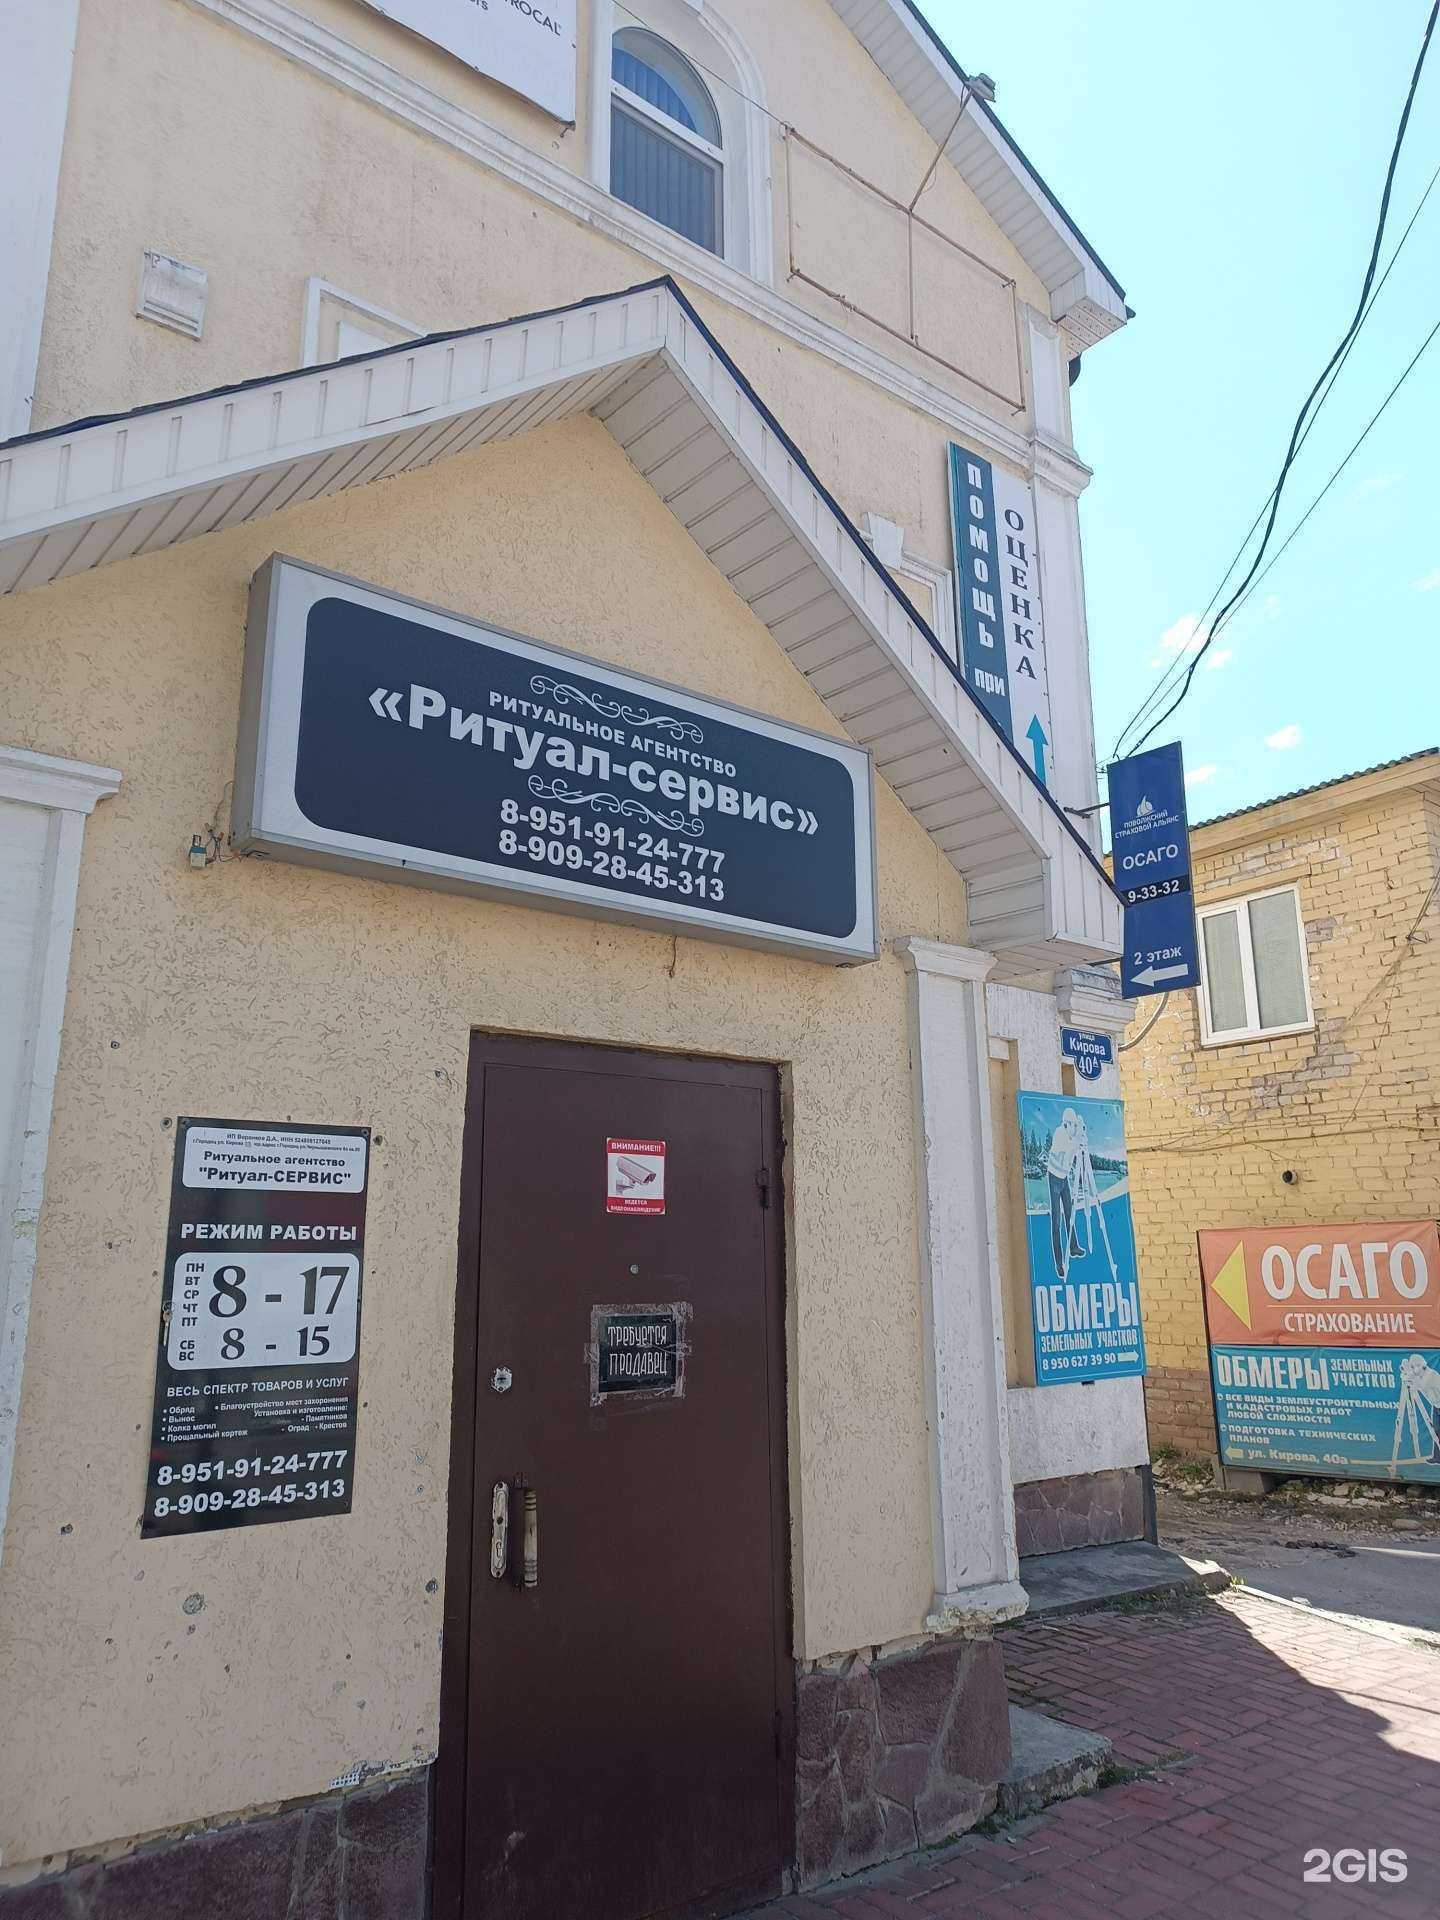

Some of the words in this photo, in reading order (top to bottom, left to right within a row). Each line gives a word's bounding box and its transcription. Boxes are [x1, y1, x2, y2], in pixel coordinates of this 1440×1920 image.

[967, 462, 997, 648] ПОМОЩЬ
[1004, 508, 1037, 680] ОЦЕНКА
[974, 667, 1006, 696] при
[488, 691, 625, 746] РИТУАЛЬНОЕ
[631, 734, 736, 778] АГЕНТСТВО
[368, 683, 819, 837] «Ритуал-сервис»
[1115, 822, 1152, 839] СТРАХОВОЙ
[1153, 815, 1179, 829] АЛЬЯНС
[1123, 809, 1168, 829] ПОВОЛЖСКИЙ
[500, 798, 726, 875] 8-951-91-24-777
[499, 829, 725, 901] 8-909-28-45-313
[1122, 844, 1179, 870] ОСАГО
[1128, 879, 1179, 903] 9-33-32
[1134, 952, 1142, 965] 2
[1146, 946, 1182, 962] этаж
[1070, 1037, 1105, 1055] Кирова
[611, 1142, 661, 1152] ВНИМАНИЕ!!!
[203, 1151, 281, 1165] Ритуальное
[284, 1156, 346, 1168] агентство
[199, 1167, 351, 1185] "Ритуал-СЕРВИС"
[181, 1223, 263, 1240] РЕЖИМ
[270, 1224, 356, 1241] РАБОТЫ
[186, 1263, 204, 1272] ПН
[1261, 1241, 1429, 1300] ОСАГО
[185, 1277, 200, 1285] ВТ
[184, 1290, 199, 1299] СР
[208, 1265, 247, 1318] 8
[300, 1266, 350, 1315] 17
[182, 1303, 198, 1313] ЧТ
[1035, 1282, 1139, 1332] ОБМЕРЫ
[181, 1317, 198, 1326] ПТ
[1284, 1312, 1417, 1334] СТРАХОВАНИЕ
[179, 1340, 195, 1350] СБ
[220, 1328, 245, 1360] 8
[297, 1325, 330, 1356] 15
[1041, 1332, 1093, 1353] ЗЕМЕЛЬНЫХ
[1097, 1329, 1138, 1348] УЧАСТКОВ
[178, 1351, 195, 1361] ВС
[1042, 1359, 1049, 1370] 8
[1051, 1357, 1069, 1370] 950
[1071, 1355, 1088, 1368] 627
[1090, 1355, 1103, 1366] 39
[1104, 1354, 1116, 1364] 90
[1216, 1355, 1330, 1391] ОБМЕРЫ
[1330, 1358, 1393, 1373] ЗЕМЕЛЬНЫХ
[167, 1384, 200, 1397] ВЕСЬ
[203, 1382, 248, 1395] СПЕКТР
[252, 1379, 303, 1392] ТОВАРОВ
[306, 1380, 314, 1389] И
[315, 1377, 349, 1389] УСЛУГ
[1331, 1372, 1396, 1389] УЧАСТКОВ
[220, 1400, 284, 1411] Благоустройство
[286, 1399, 302, 1407] мест
[1225, 1393, 1243, 1401] ВСЕ
[1244, 1394, 1274, 1404] ВИДЫ
[169, 1406, 195, 1414] Обряд
[254, 1408, 291, 1417] Установка
[305, 1413, 347, 1422] Памятников
[1227, 1410, 1264, 1420] ЛЮБОЙ
[1266, 1413, 1331, 1424] СЛОЖНОСТИ
[1236, 1403, 1313, 1415] КАДАСТРОВЫХ
[1316, 1408, 1352, 1416] РАБОТ
[168, 1415, 195, 1423] Вынос
[319, 1422, 347, 1431] Крестов
[167, 1431, 220, 1442] Прощальный
[287, 1424, 310, 1433] Оград
[1228, 1424, 1296, 1437] ПОДГОТОВКА
[1298, 1429, 1377, 1442] ТЕХНИЧЕСКИХ
[1229, 1434, 1270, 1445] ПЛАНОВ
[1247, 1449, 1266, 1460] ул.
[157, 1449, 348, 1486] 8-951-91-24-777
[153, 1478, 345, 1518] 8-909-28-45-313
